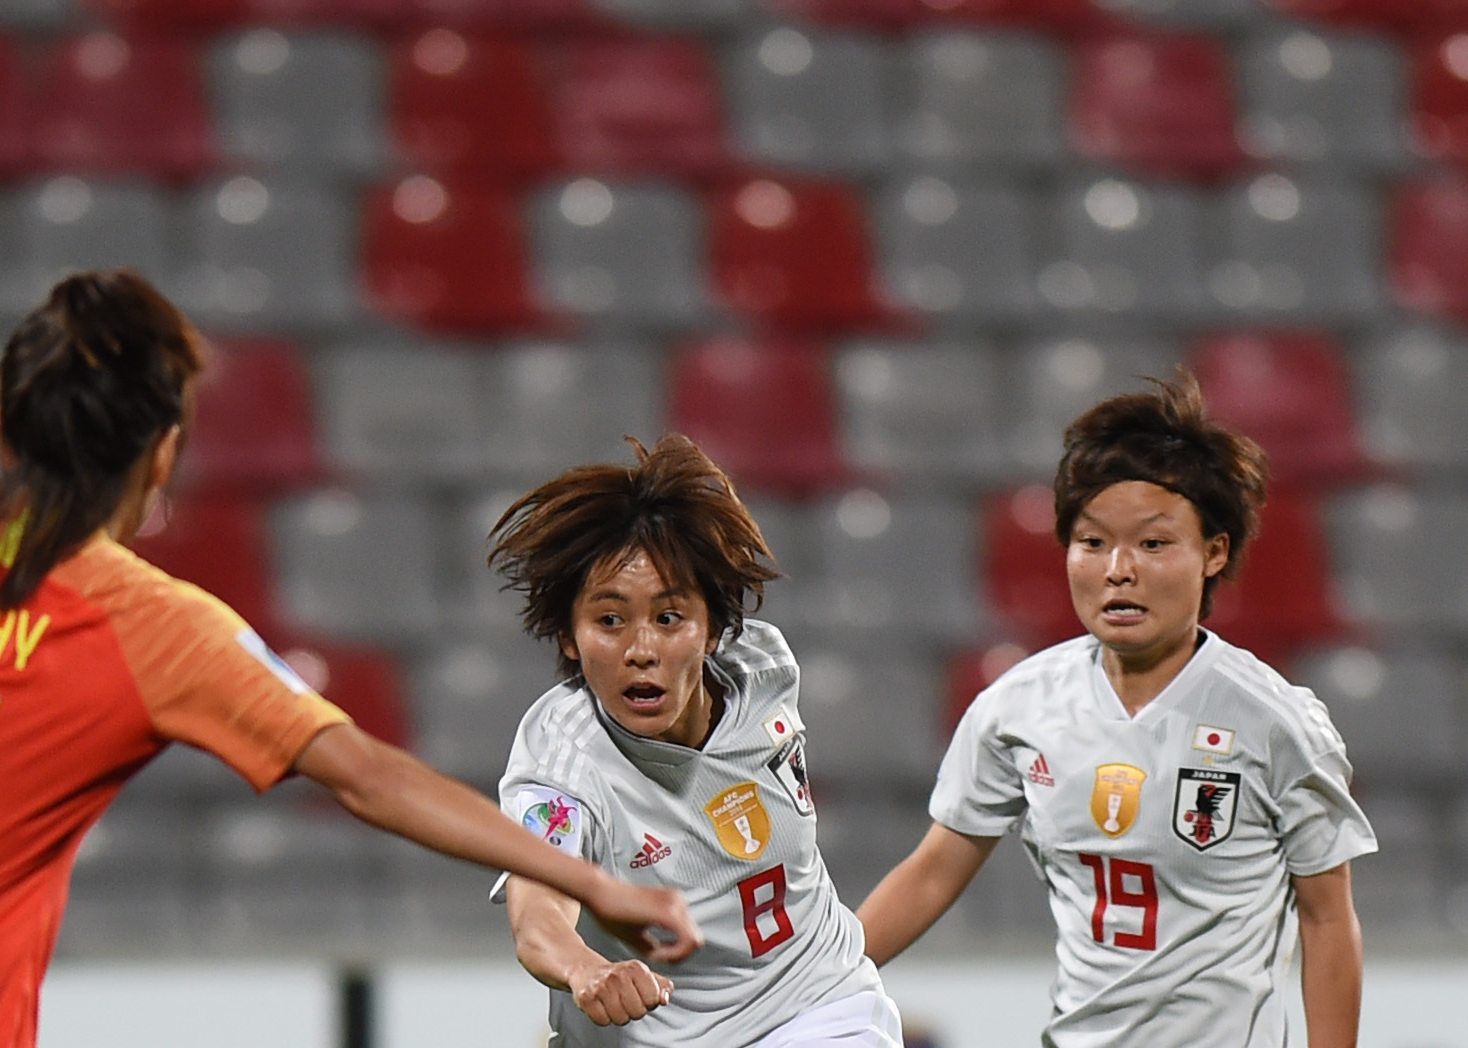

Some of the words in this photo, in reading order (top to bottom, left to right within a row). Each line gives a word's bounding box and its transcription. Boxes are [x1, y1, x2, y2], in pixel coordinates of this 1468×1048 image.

[1192, 770, 1227, 780] JAPAN
[629, 846, 672, 869] adidas
[737, 863, 794, 958] 8
[1078, 853, 1159, 952] 19
